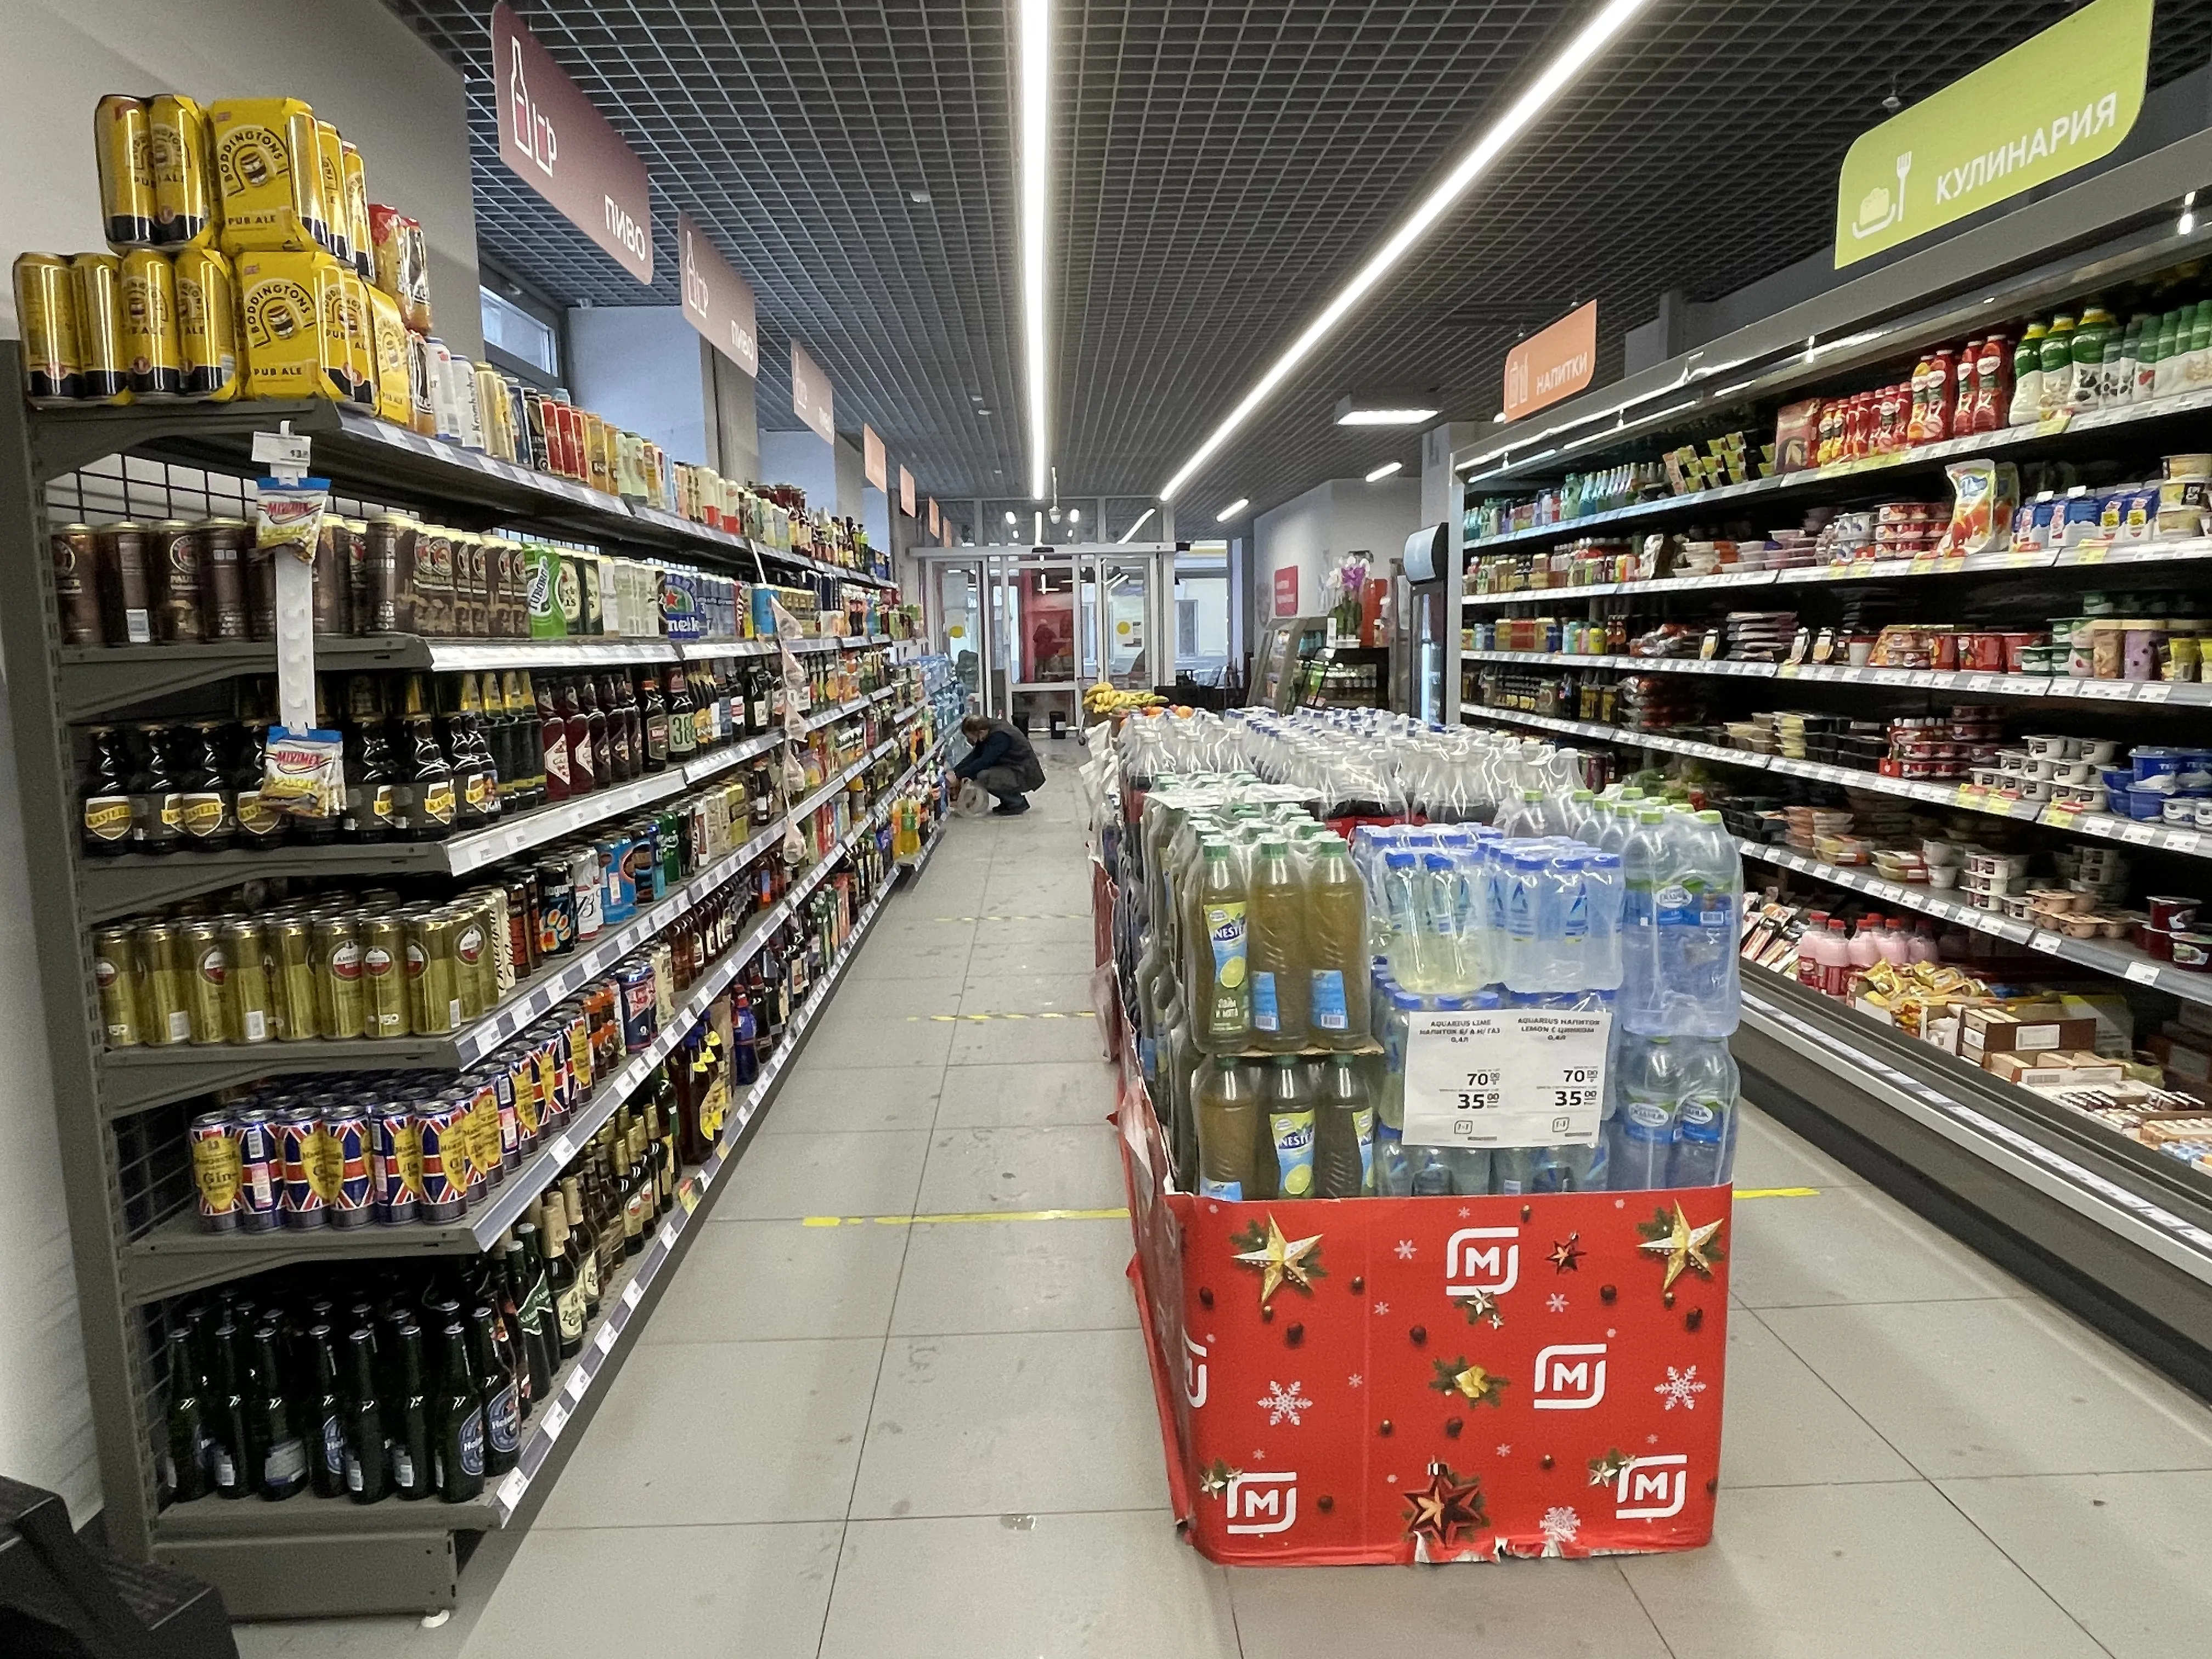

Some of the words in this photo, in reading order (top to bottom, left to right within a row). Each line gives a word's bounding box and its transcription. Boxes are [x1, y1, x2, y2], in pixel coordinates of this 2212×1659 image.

[219, 131, 283, 183] BODDINGTONS
[1936, 91, 2117, 205] КУЛИНАРИЯ
[228, 216, 250, 225] PUB
[256, 215, 276, 224] ALE
[605, 195, 647, 261] ПИВО
[247, 284, 311, 334] BODDINGTONS
[731, 320, 754, 366] ПИВО
[254, 368, 276, 376] PUB
[281, 366, 302, 375] ALE
[1537, 351, 1588, 396] НАПИТКИ
[1467, 1073, 1488, 1086] 70
[1563, 1069, 1585, 1083] 70
[1457, 1093, 1485, 1109] 35
[1554, 1091, 1582, 1107] 35
